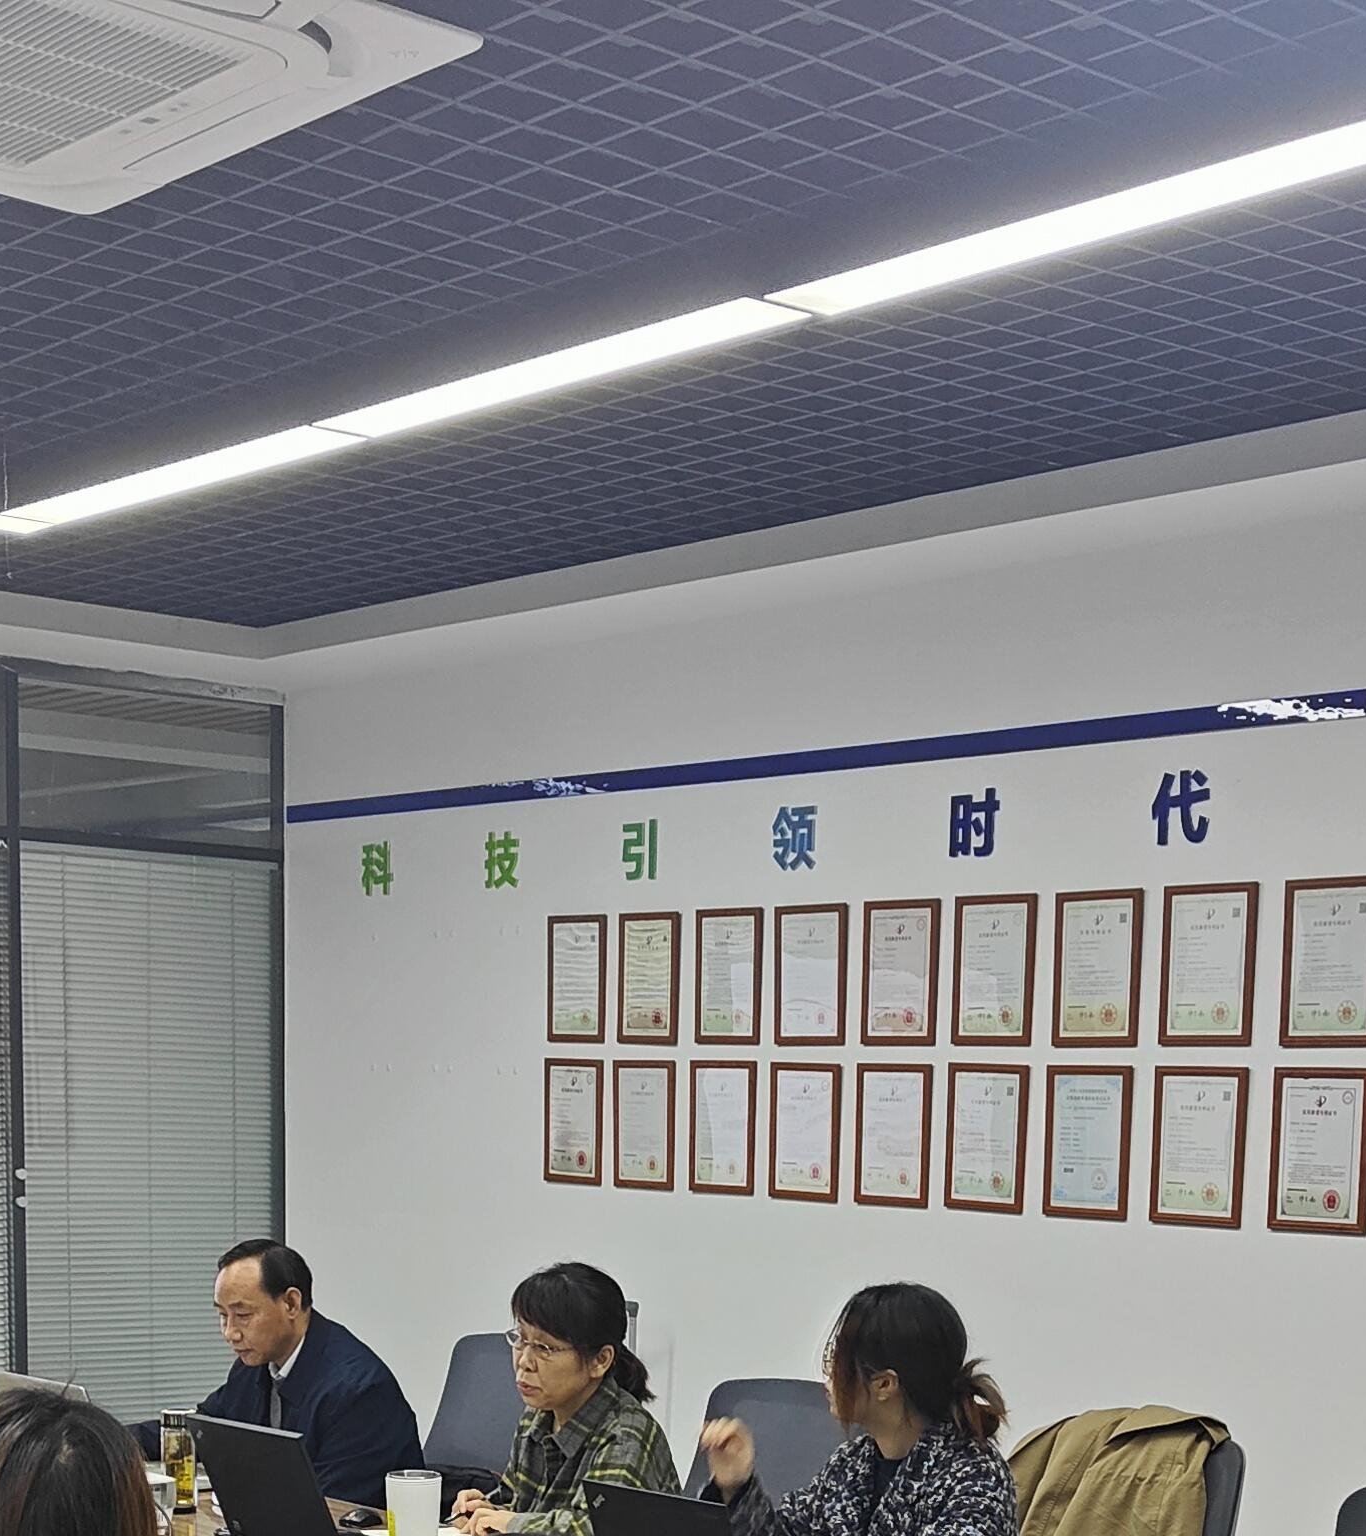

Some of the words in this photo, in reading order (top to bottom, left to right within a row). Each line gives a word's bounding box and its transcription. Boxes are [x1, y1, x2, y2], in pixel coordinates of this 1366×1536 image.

[361, 771, 1211, 896] 科技引领时代
